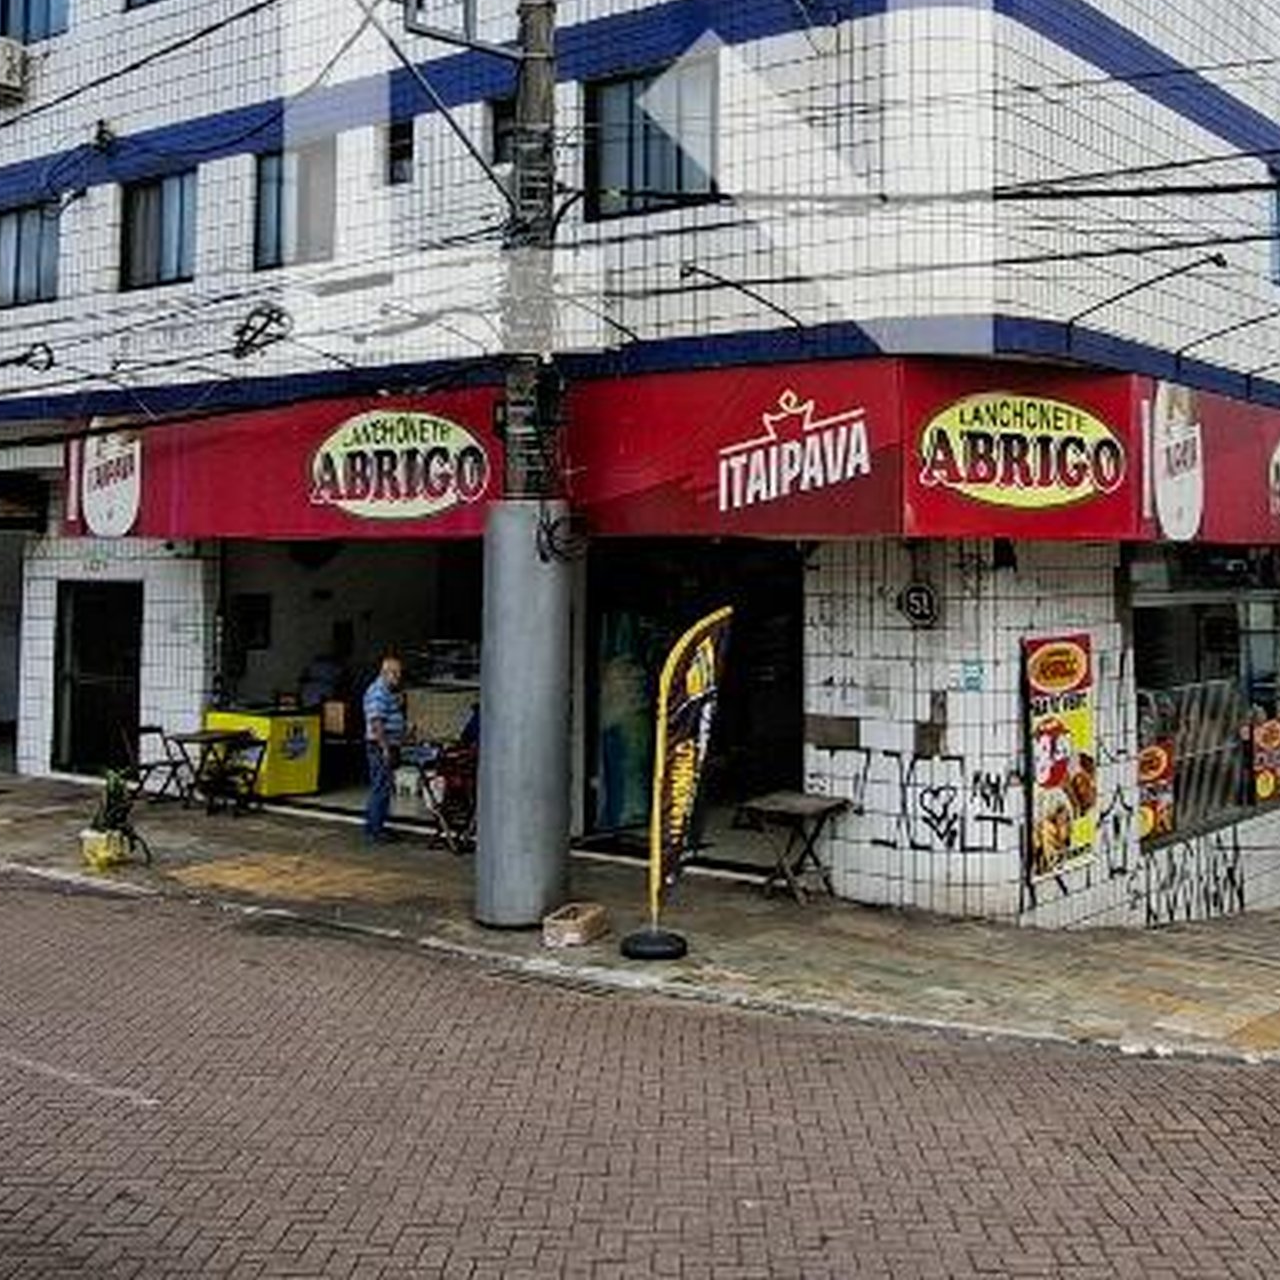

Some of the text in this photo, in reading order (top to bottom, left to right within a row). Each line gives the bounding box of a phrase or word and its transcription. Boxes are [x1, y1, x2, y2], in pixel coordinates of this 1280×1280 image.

[959, 401, 1087, 432] LANCHONETE
[309, 446, 490, 504] ABRIGO
[719, 421, 870, 511] ITAIPAVA
[920, 427, 1125, 493] ABRIGO
